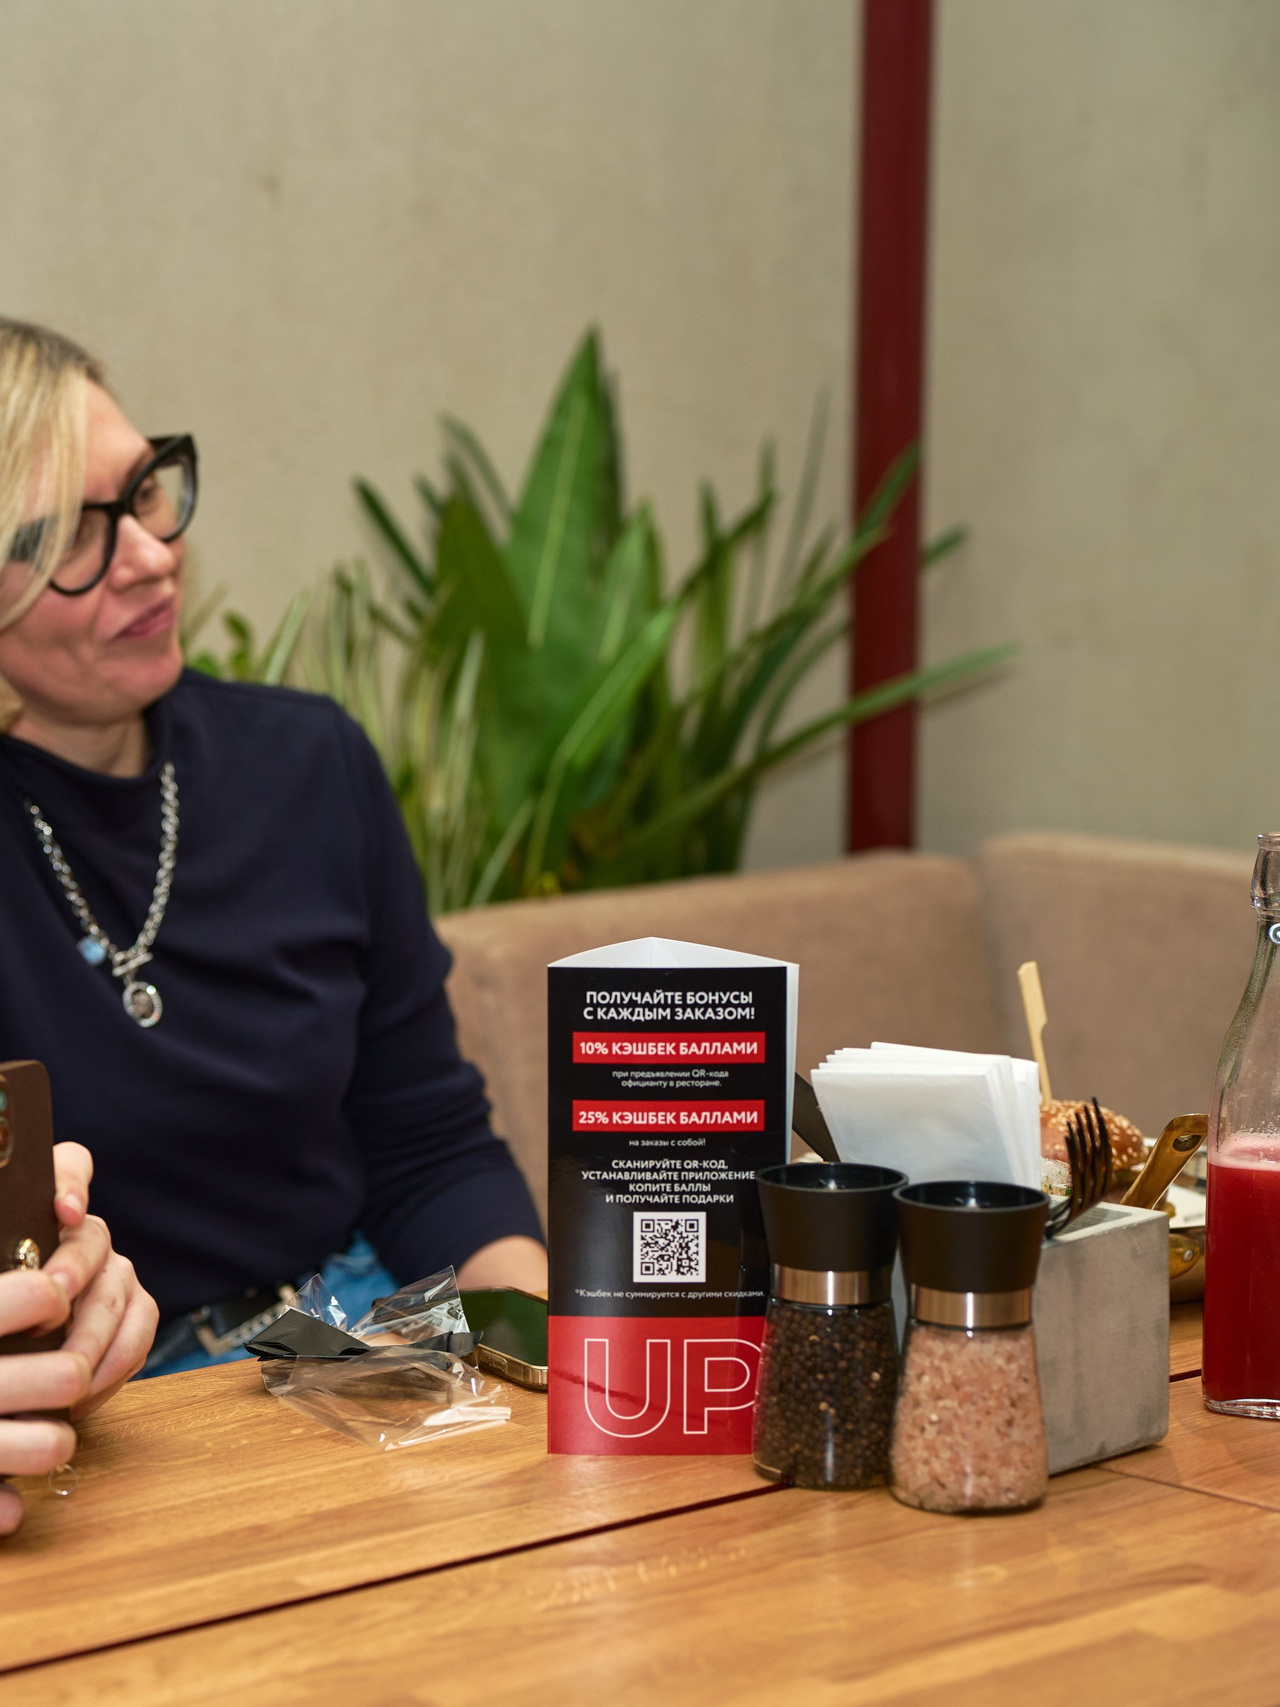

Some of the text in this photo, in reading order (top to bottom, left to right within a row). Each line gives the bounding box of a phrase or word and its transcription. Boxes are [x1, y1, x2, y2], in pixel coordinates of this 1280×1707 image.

[586, 990, 753, 1004] ПОЛУЧАЙТЕ БОНУСЫ
[583, 1007, 755, 1022] С КАЖДЫМ ЗАКАЗОМ!
[580, 1042, 758, 1055] 10% КЭШБЕК БАЛЛАМИ
[612, 1069, 729, 1078] при предъявлении QR-кода
[621, 1079, 668, 1088] официанту
[676, 1080, 722, 1088] ресторане.
[579, 1111, 758, 1124] 25% КЭШБЕК БАЛЛАМИ
[677, 1138, 706, 1147] собой!
[611, 1158, 728, 1170] СКАНИРУЙТЕ QR-КОД,
[581, 1169, 756, 1181] УСТАНАВЛИВАЙТЕ ПРИЛОЖЕНИЕ
[629, 1182, 711, 1192] КОПИТЕ БАЛЛЫ
[606, 1193, 734, 1204] И ПОЛУЧАЙТЕ ПОДАРКИ
[625, 1291, 680, 1299] суммируется
[687, 1291, 722, 1299] другими
[724, 1290, 765, 1298] скидками.
[584, 1338, 762, 1438] UP
